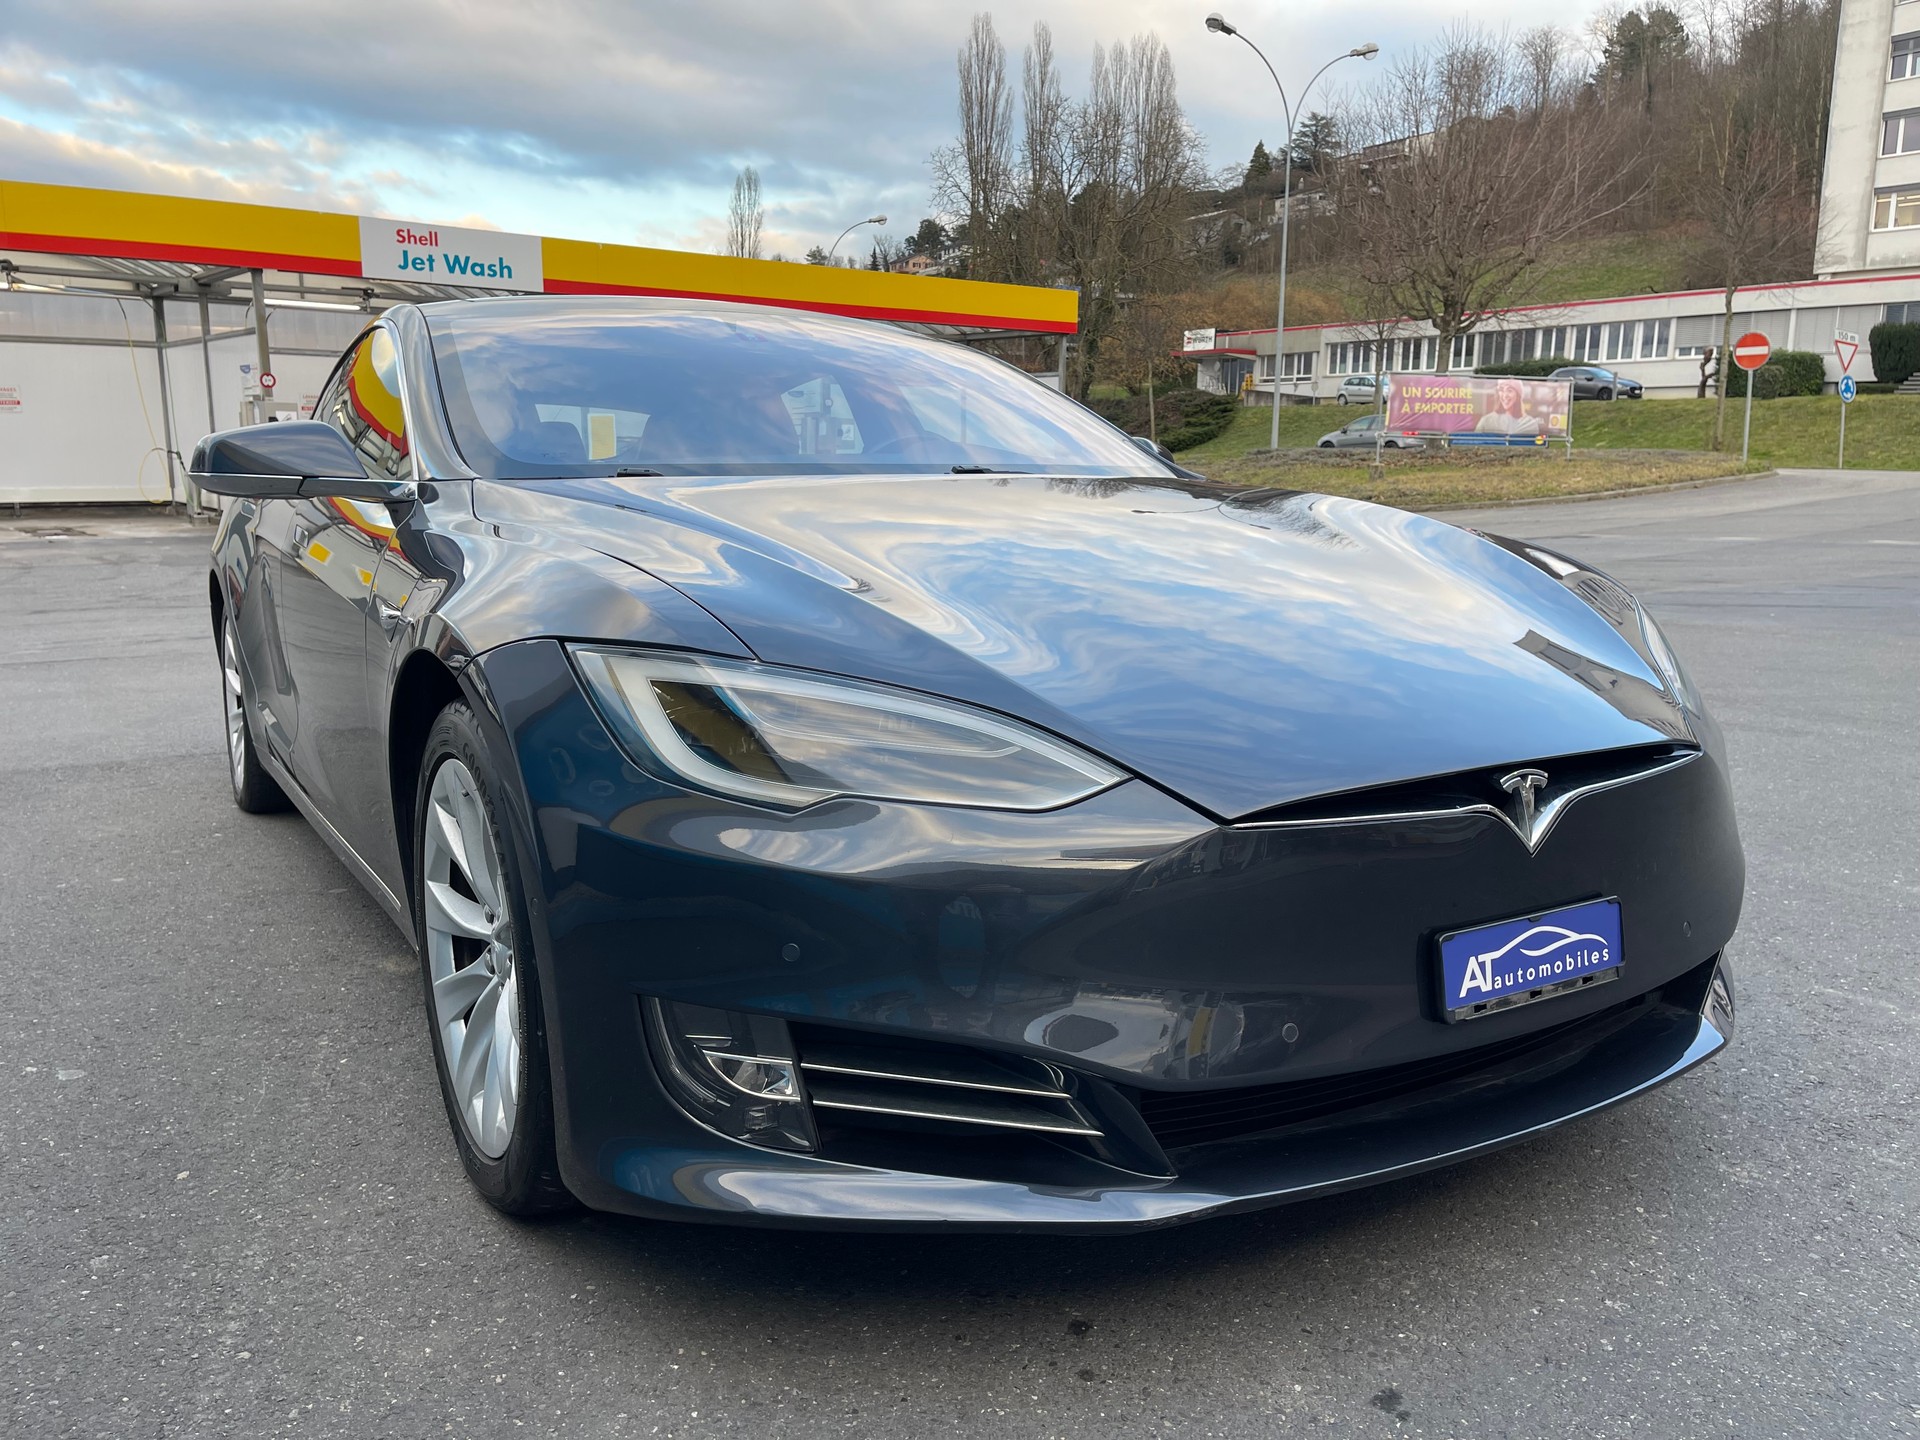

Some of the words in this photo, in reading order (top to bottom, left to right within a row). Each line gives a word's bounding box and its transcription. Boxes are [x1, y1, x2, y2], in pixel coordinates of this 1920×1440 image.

[396, 228, 438, 247] Shell
[398, 249, 435, 272] Jet
[443, 253, 512, 279] Wash
[1402, 386, 1421, 398] UN
[1425, 386, 1473, 399] SOURIRE
[1401, 399, 1410, 413] À
[1415, 402, 1474, 414] EMPORTER
[1493, 948, 1610, 990] automobiles
